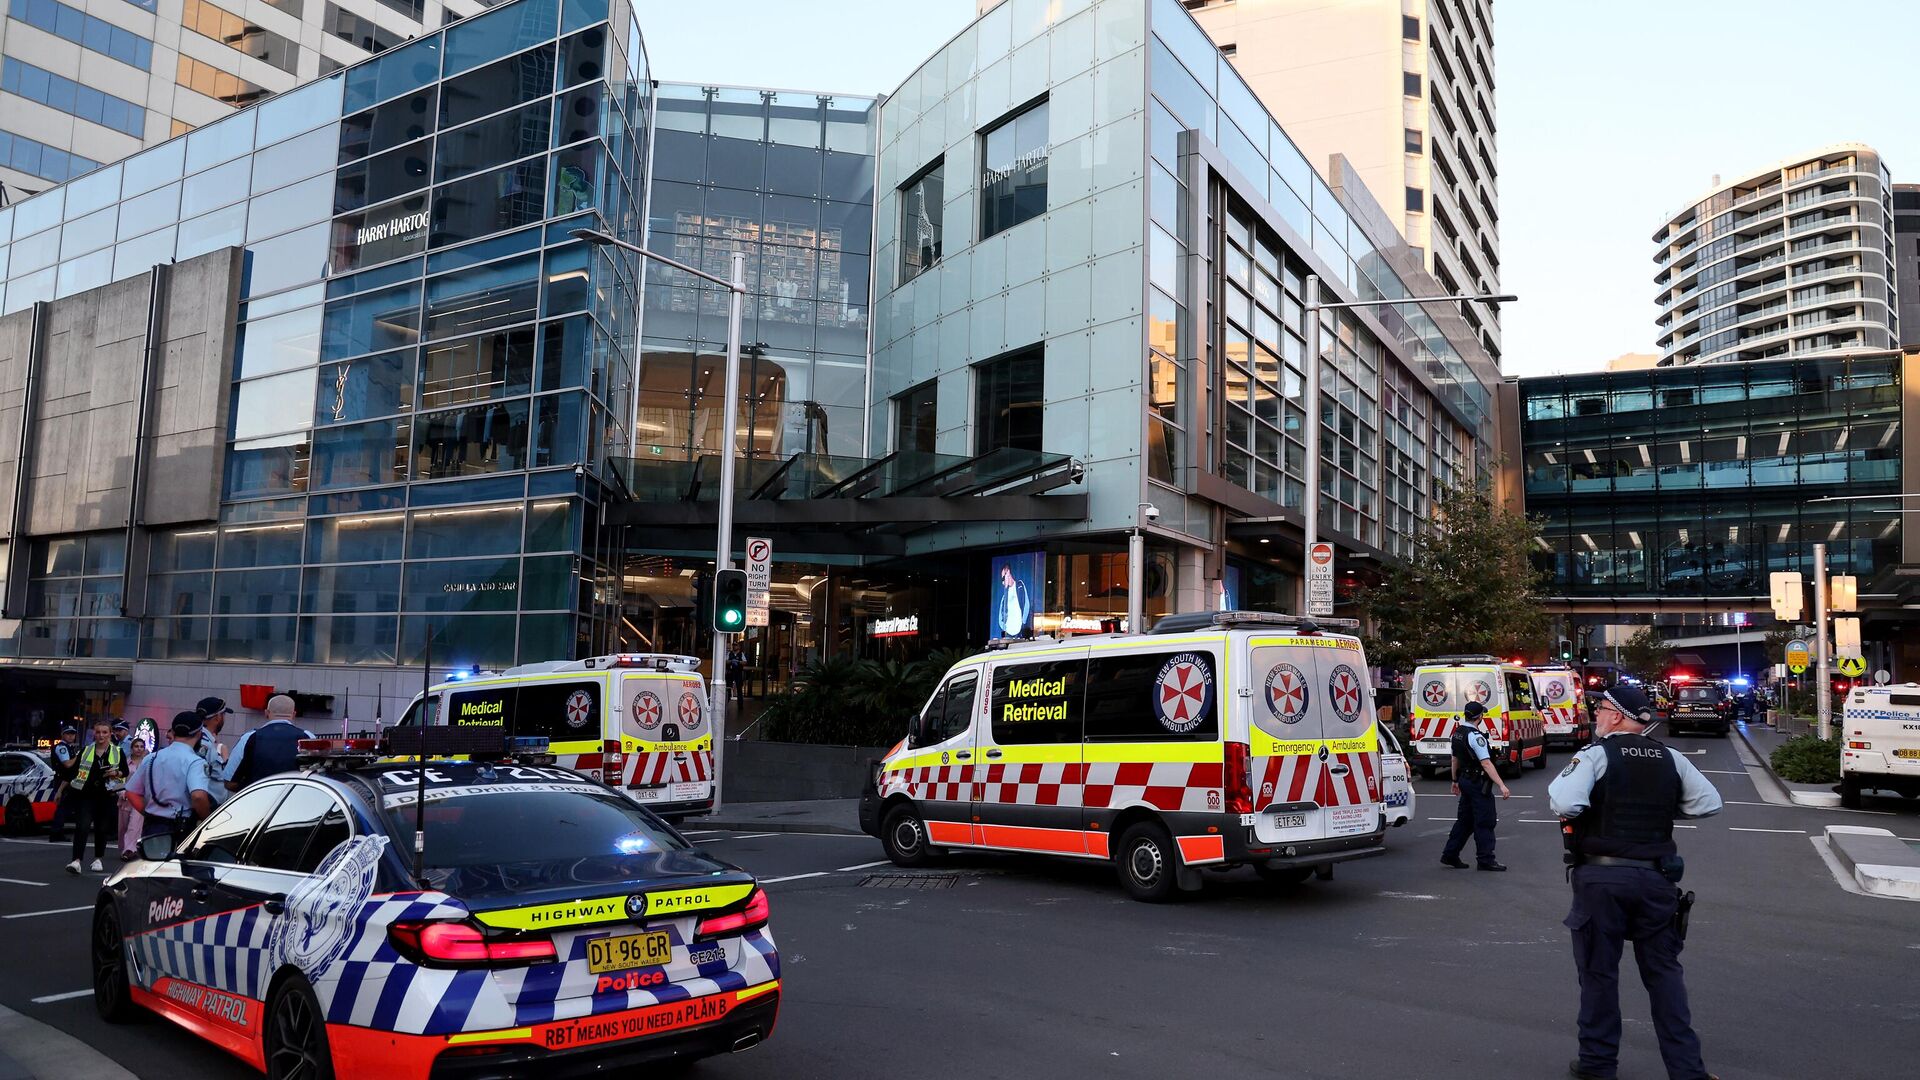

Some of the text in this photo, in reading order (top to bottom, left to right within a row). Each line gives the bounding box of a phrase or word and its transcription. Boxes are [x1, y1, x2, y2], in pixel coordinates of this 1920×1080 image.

[983, 160, 1013, 189] HARRY
[357, 211, 429, 245] HARRY HARTOG
[751, 564, 765, 572] NO
[498, 581, 517, 591] MAR
[1290, 638, 1332, 647] PARAMEDIC
[1156, 653, 1212, 685] NEW SOUTH WALES
[1265, 663, 1307, 688] NEW SOUTH WALES
[1008, 676, 1066, 698] Medical
[461, 700, 503, 716] Medical
[1003, 701, 1068, 721] Retrieval
[1880, 710, 1910, 718] Police
[1160, 714, 1203, 732] AMBULANCE
[1272, 710, 1304, 724] AMBULANCE
[654, 743, 687, 751] Ambulance
[1272, 742, 1315, 755] Emergency
[1331, 740, 1366, 750] Ambulance
[1621, 747, 1663, 758] POLICE
[382, 766, 586, 786] CE 213
[467, 785, 523, 795] Drink
[549, 785, 600, 794] Drive
[1207, 797, 1220, 805] 000
[655, 894, 711, 908] PATROL
[148, 896, 184, 924] Police
[531, 903, 616, 922] HIGHWAY
[294, 956, 312, 967] FORCE
[618, 961, 639, 969] SOUTH
[641, 957, 661, 966] WALES
[690, 947, 726, 965] CE213
[597, 971, 665, 993] Police
[166, 980, 247, 1026] HIGHWAY PATROL
[545, 999, 728, 1047] RBT MEANS YOU NEED A PLAN B
